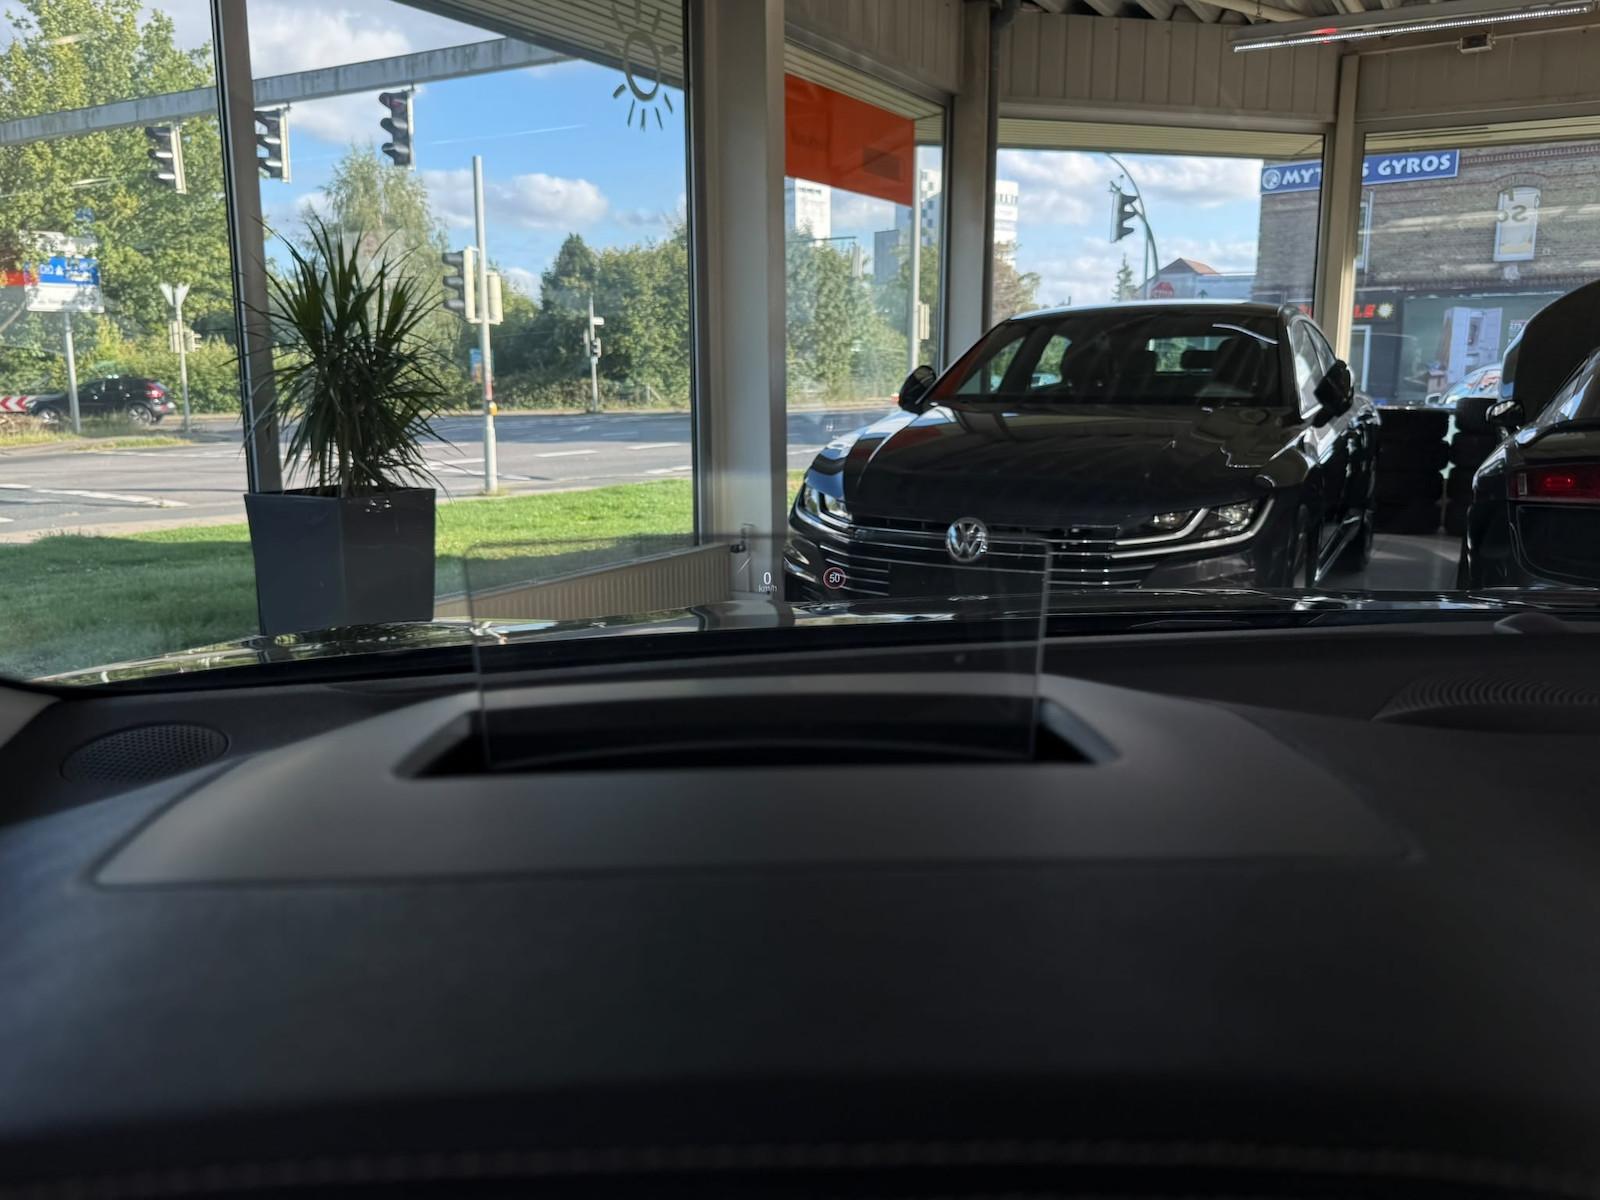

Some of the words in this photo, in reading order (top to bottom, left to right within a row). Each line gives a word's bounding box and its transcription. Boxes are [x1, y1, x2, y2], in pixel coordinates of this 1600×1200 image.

[1377, 154, 1450, 176] GYROS
[946, 518, 988, 561] VW
[763, 572, 772, 585] 0
[829, 573, 841, 583] 50
